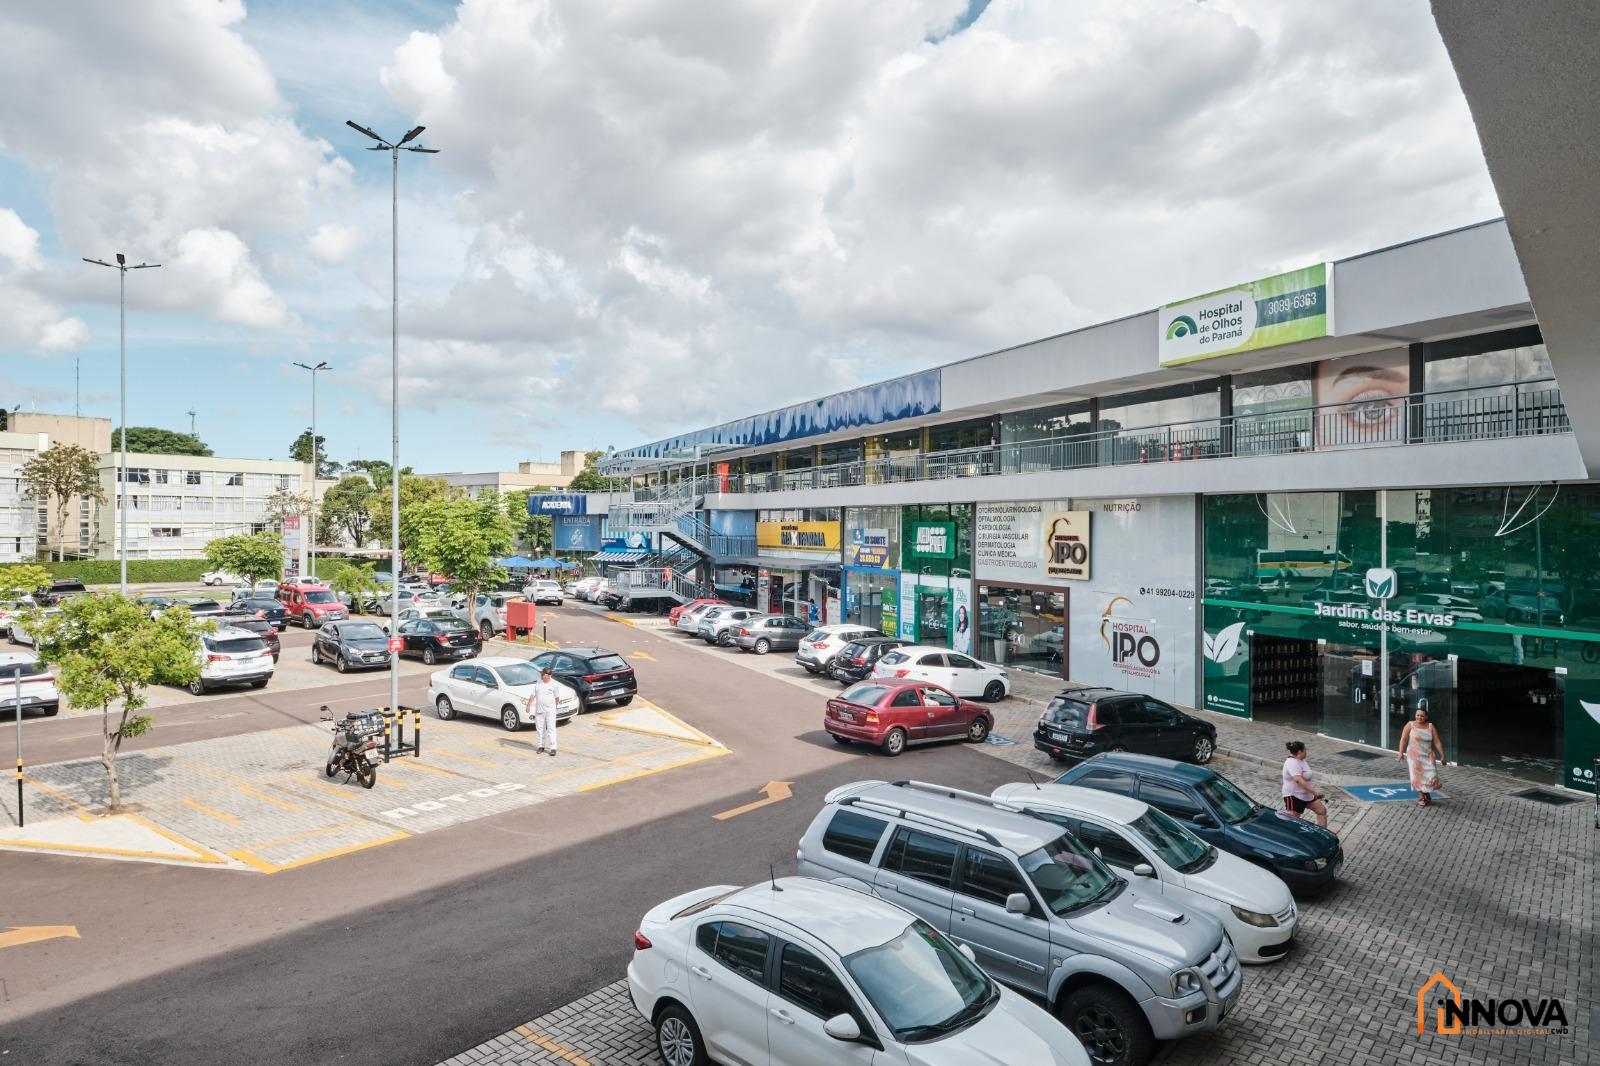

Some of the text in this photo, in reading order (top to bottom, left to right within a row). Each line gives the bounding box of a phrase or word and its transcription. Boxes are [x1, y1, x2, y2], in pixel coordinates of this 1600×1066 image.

[1199, 300, 1243, 320] Hospital
[1268, 292, 1317, 315] 3089-6363
[1199, 316, 1243, 334] de Olhos
[1199, 327, 1243, 345] do Paraná
[1103, 501, 1142, 514] NUTRIÇÃO
[1054, 542, 1088, 565] IPO
[1146, 587, 1195, 599] 41 99204-0229
[1314, 602, 1455, 627] Jardim das Ervas
[1112, 622, 1149, 634] HOSPITAL
[1338, 620, 1360, 629] sabor,
[1391, 624, 1432, 636] bem-estar
[1112, 631, 1160, 667] IPO
[380, 782, 527, 819] MOTOS
